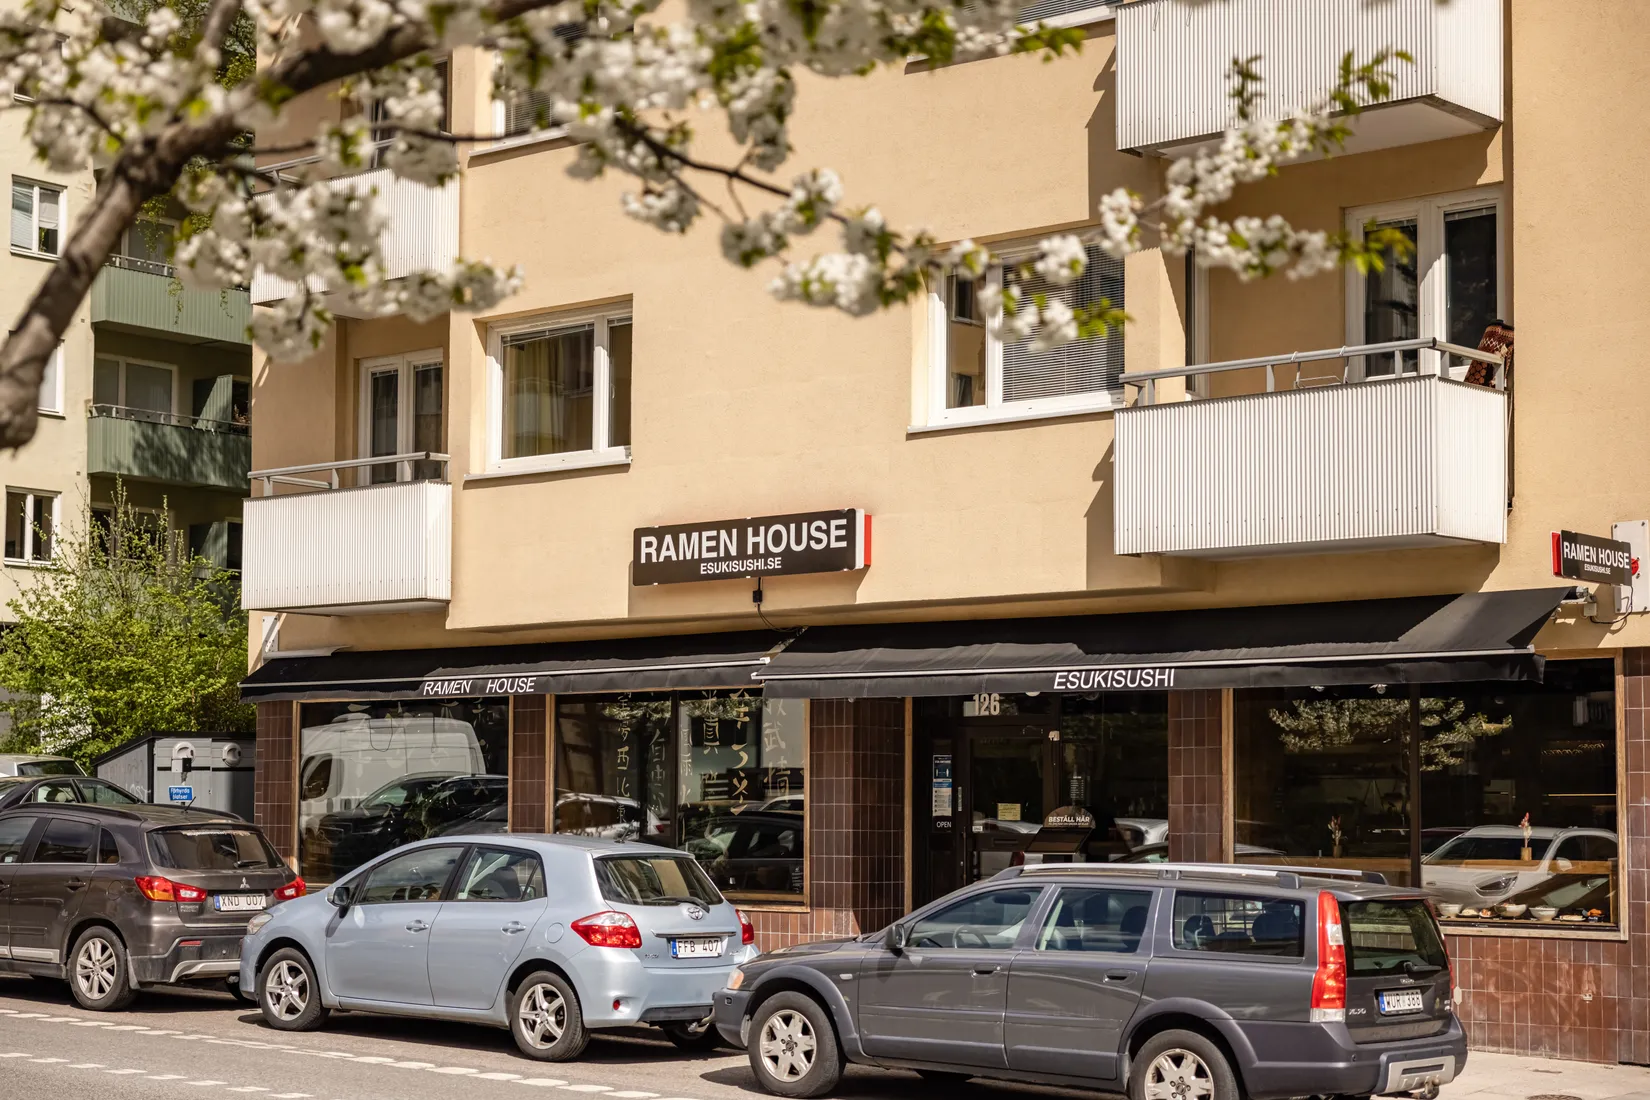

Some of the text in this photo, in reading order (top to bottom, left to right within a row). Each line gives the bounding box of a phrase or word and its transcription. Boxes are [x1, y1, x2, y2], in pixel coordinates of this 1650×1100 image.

[640, 518, 848, 565] RAMEN HOUSE
[1563, 541, 1631, 570] RAMEN HOUSE
[699, 557, 783, 575] ESUKISUSHI.SE
[423, 677, 537, 696] RAMEN HOUSE
[1053, 668, 1176, 690] ESUKISUSHI
[972, 693, 1000, 716] 126
[936, 820, 952, 829] OPEN
[221, 893, 264, 907] XND 007
[677, 939, 719, 954] FFB 407
